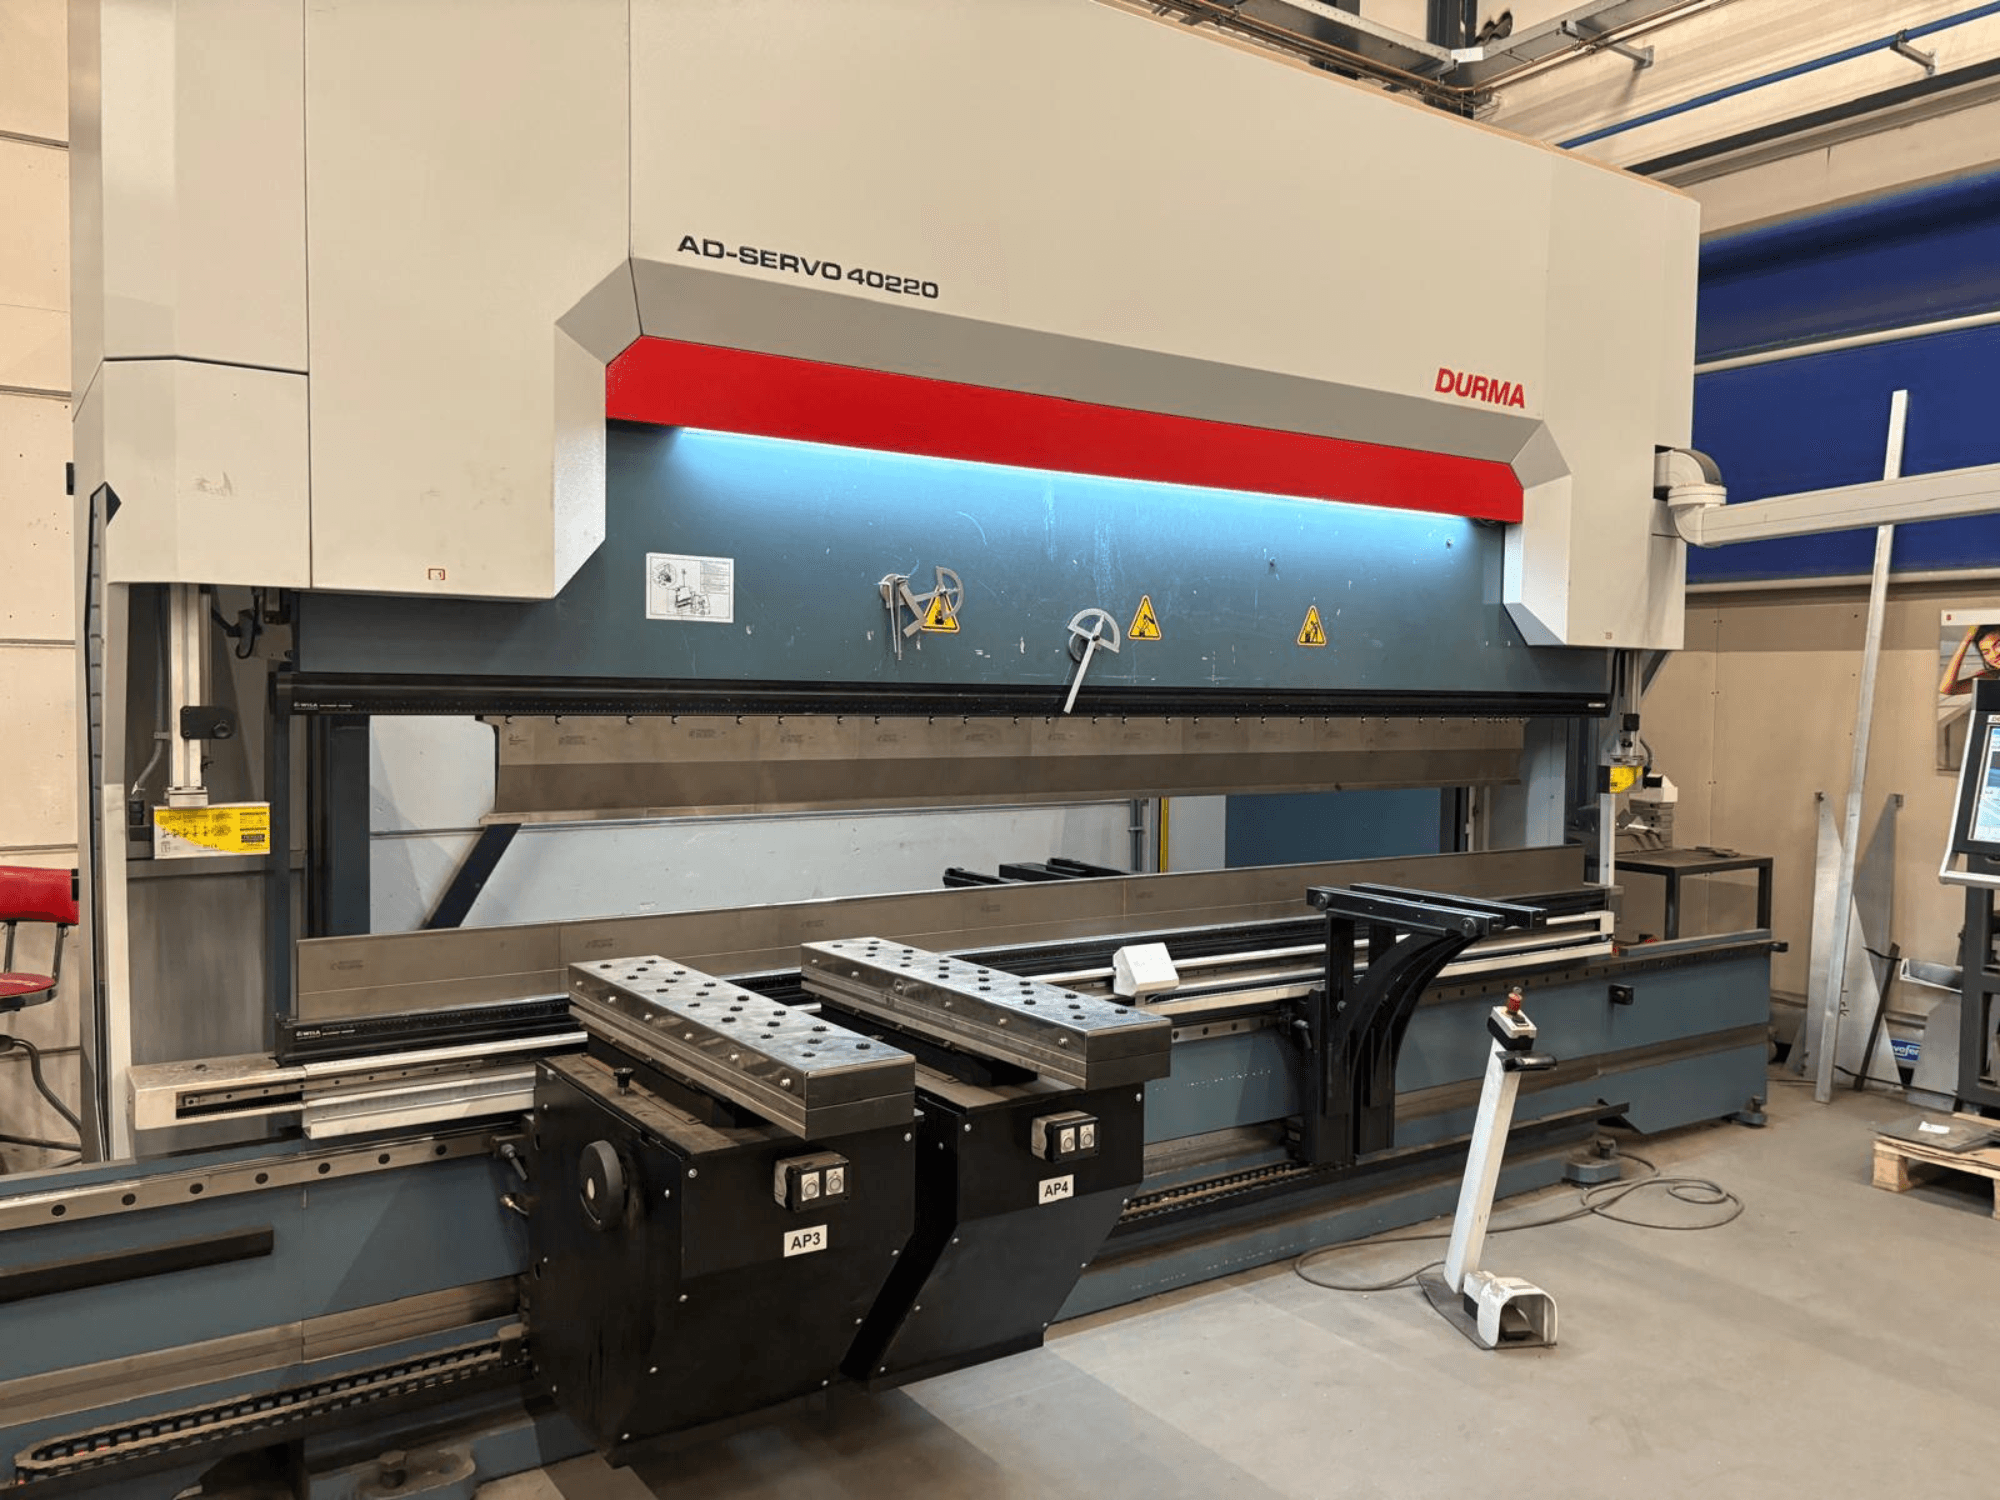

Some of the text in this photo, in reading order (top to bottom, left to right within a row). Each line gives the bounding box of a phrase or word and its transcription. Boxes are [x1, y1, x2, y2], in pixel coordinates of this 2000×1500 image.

[677, 235, 940, 299] AD-SERVO 40220
[1434, 367, 1526, 409] DURMA
[1044, 1180, 1069, 1198] AP4
[790, 1232, 822, 1250] AP3
